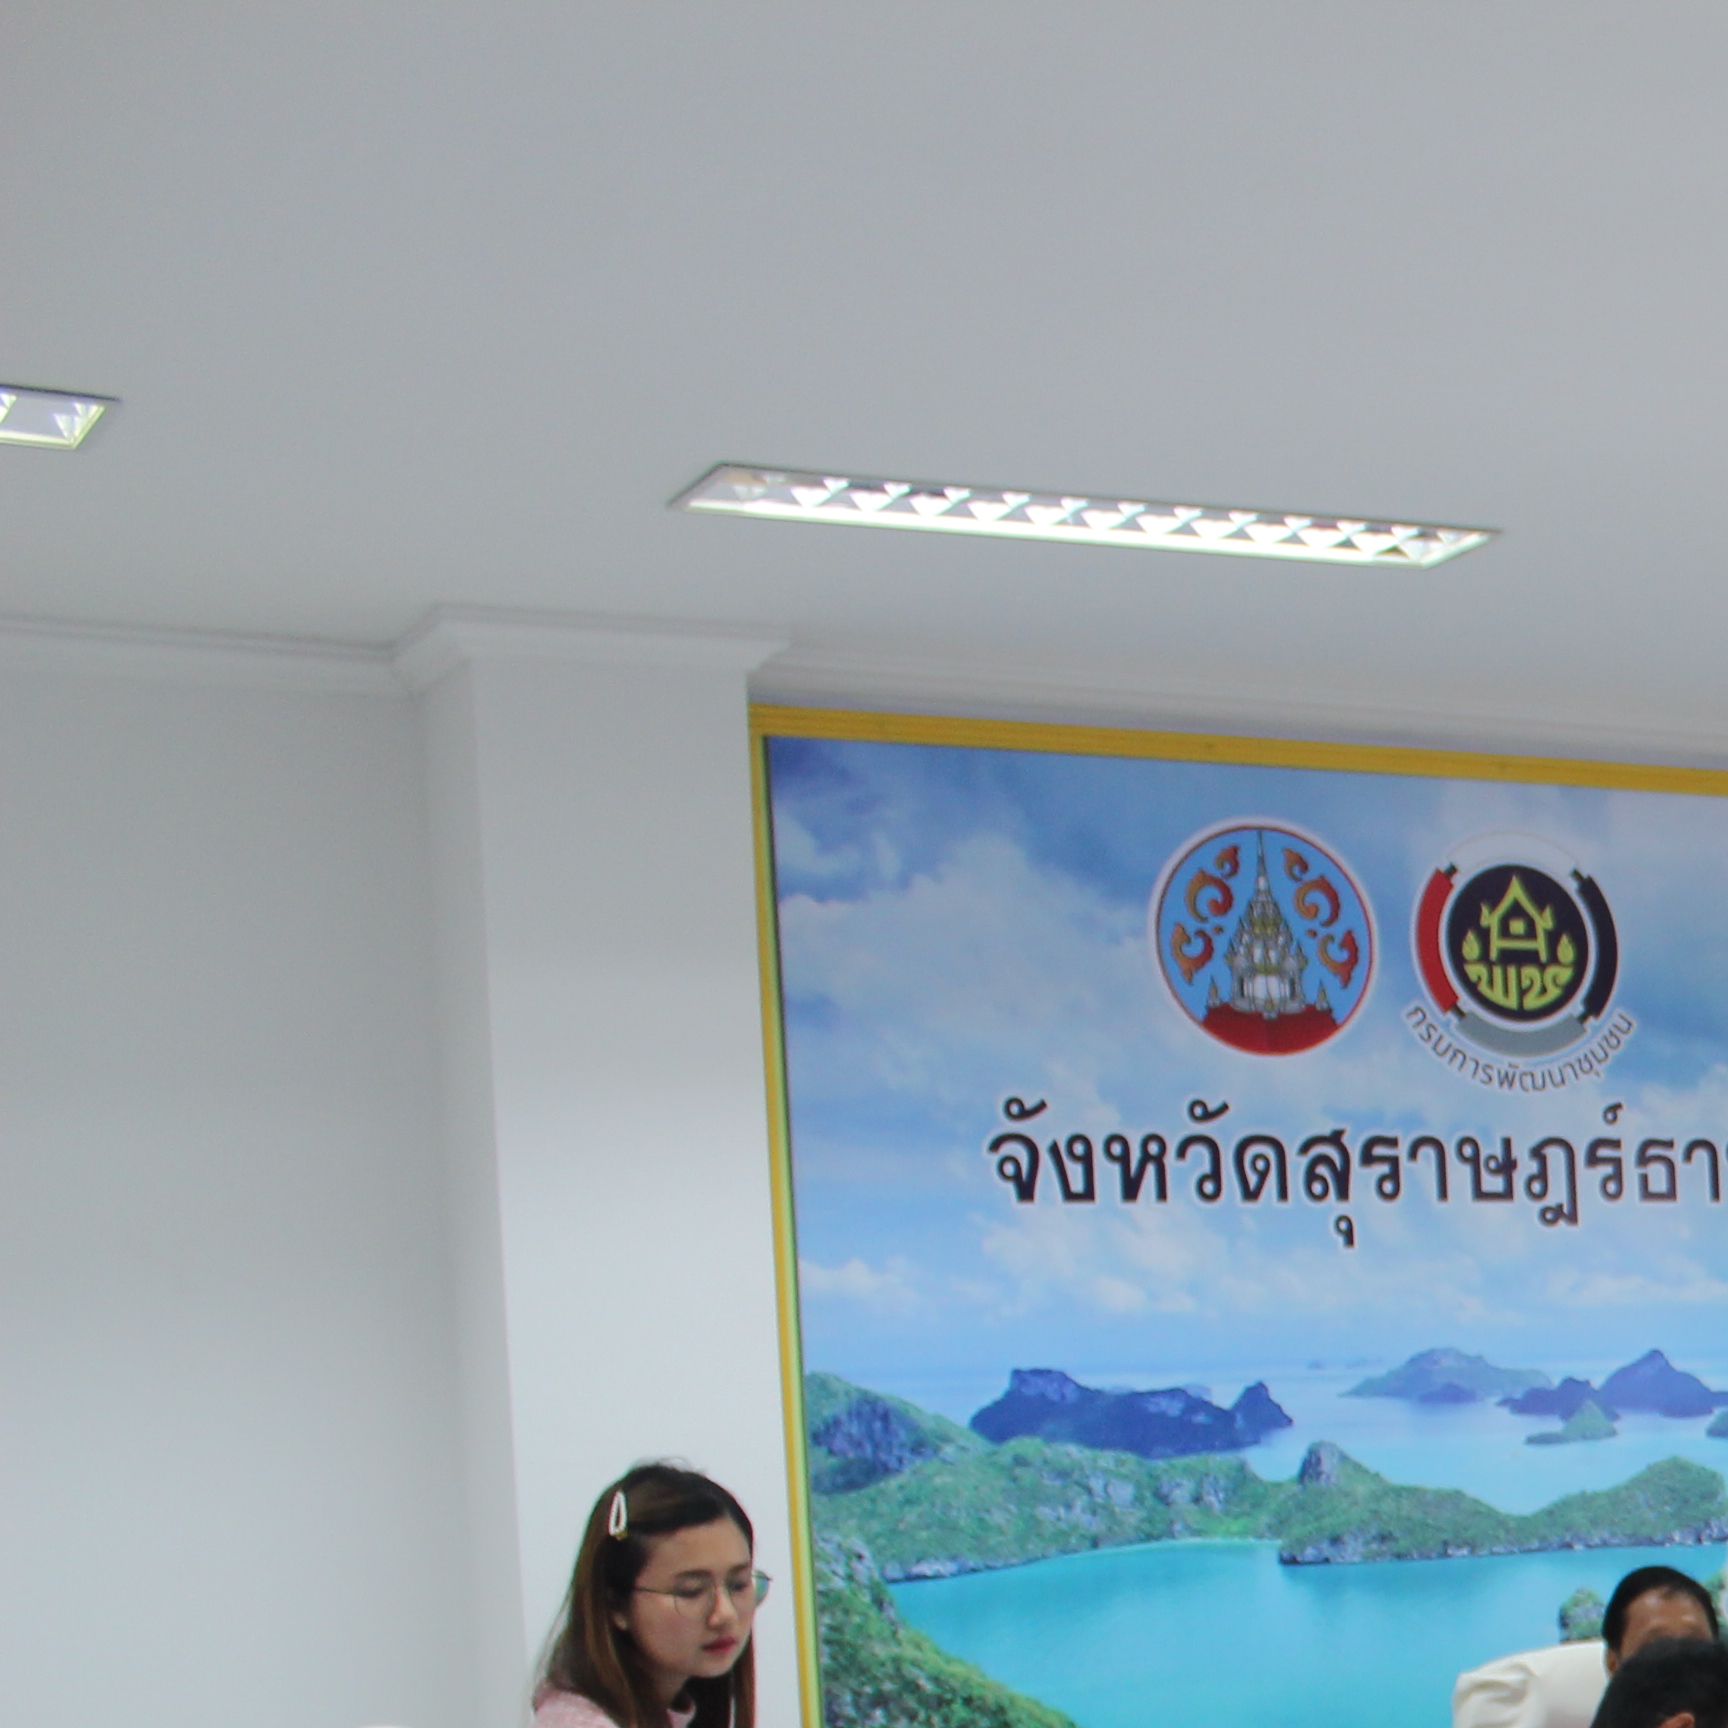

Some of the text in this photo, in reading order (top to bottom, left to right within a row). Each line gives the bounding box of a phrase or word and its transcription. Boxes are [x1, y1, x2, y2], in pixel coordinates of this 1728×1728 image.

[1405, 1004, 1634, 1093] กรมการพัฒนาชุมชน
